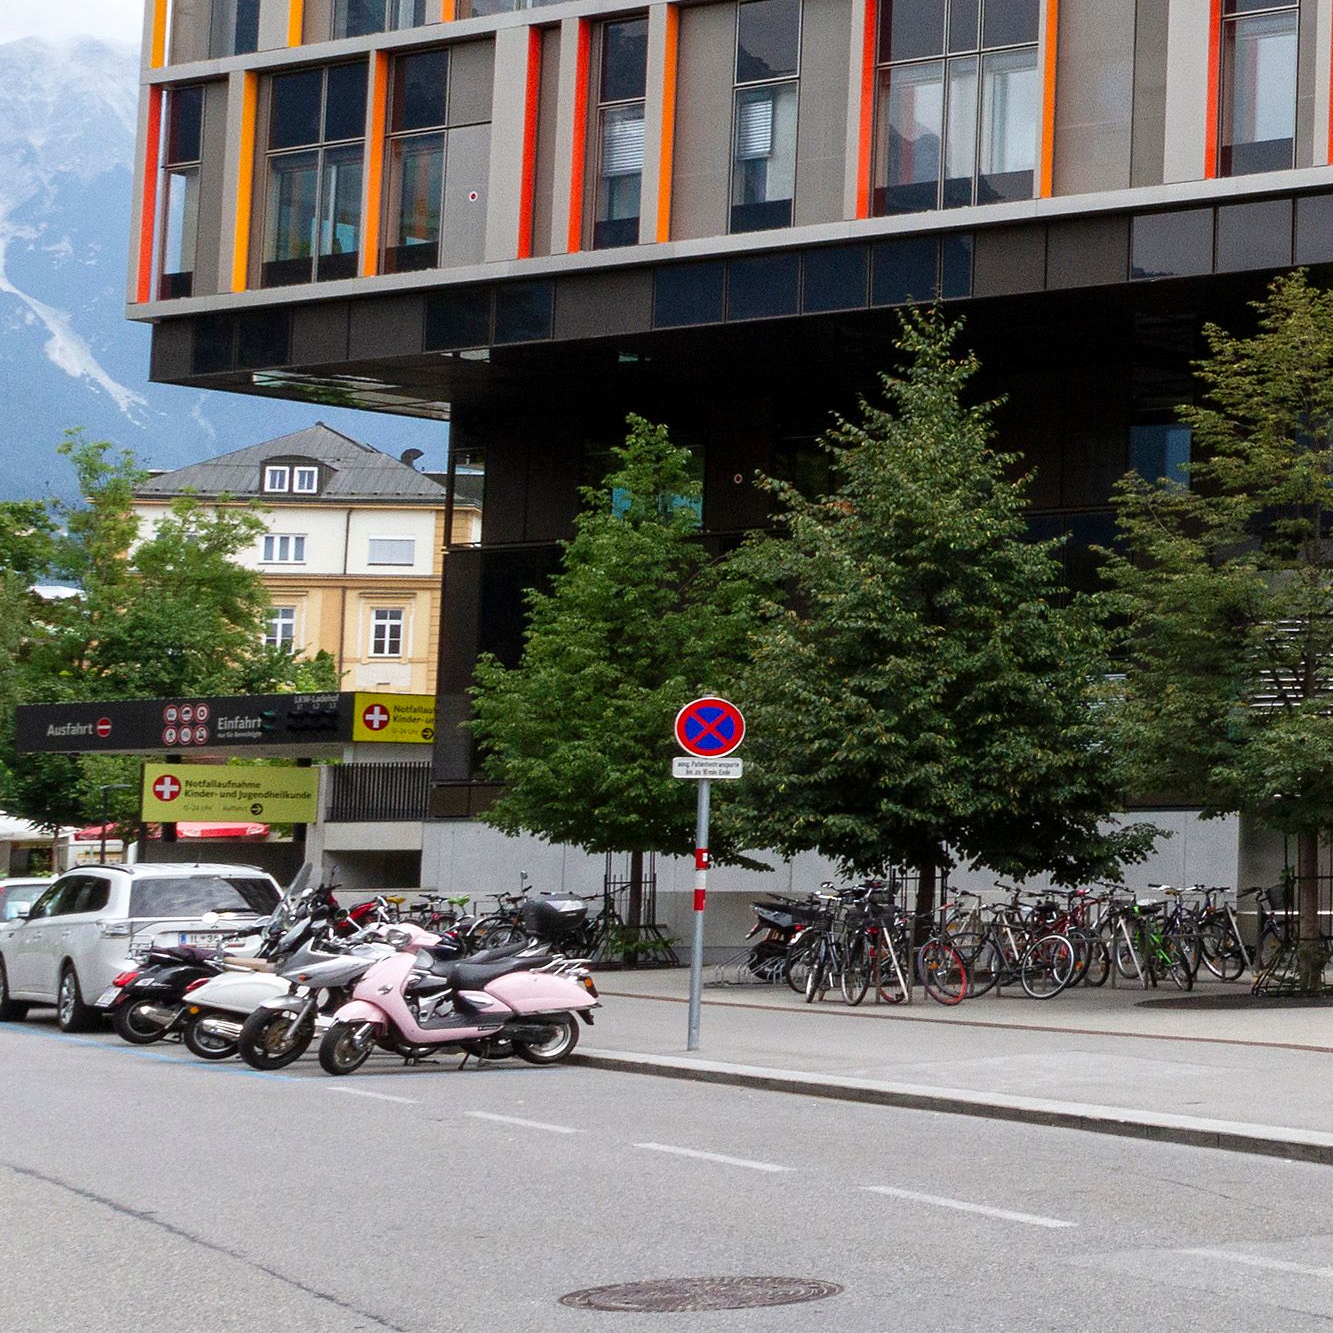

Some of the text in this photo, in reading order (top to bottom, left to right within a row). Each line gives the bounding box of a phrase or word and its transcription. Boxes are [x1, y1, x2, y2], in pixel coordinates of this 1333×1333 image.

[217, 715, 262, 730] Einfahrt
[46, 722, 94, 736] Ausfahrt
[185, 779, 262, 789] Notfallaufnahme
[184, 789, 312, 800] Kinder- und Jugendheilkunde
